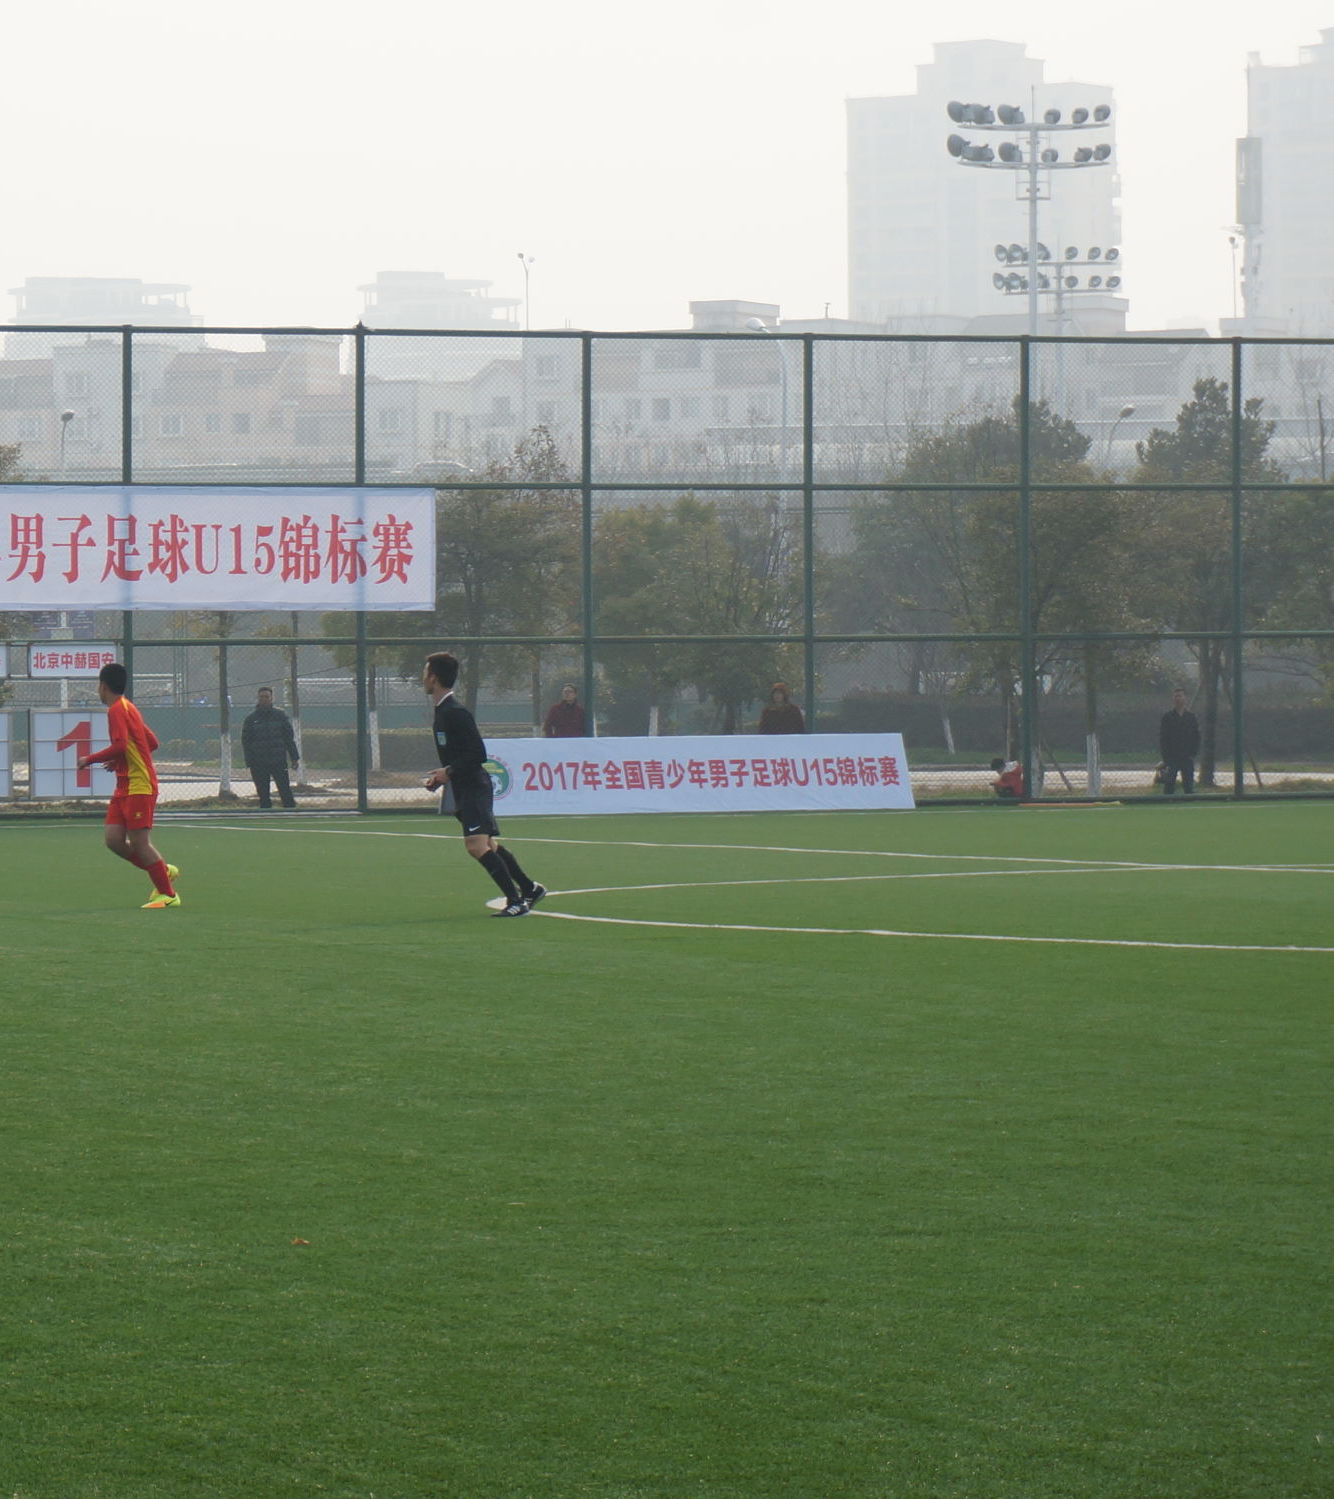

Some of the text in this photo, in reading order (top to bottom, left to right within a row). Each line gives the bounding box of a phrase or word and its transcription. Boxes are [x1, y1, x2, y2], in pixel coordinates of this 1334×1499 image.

[33, 652, 115, 670] 北京中赫国安
[57, 721, 91, 788] 1
[522, 755, 901, 791] 2017年全国青少年男子足球U15锦标赛
